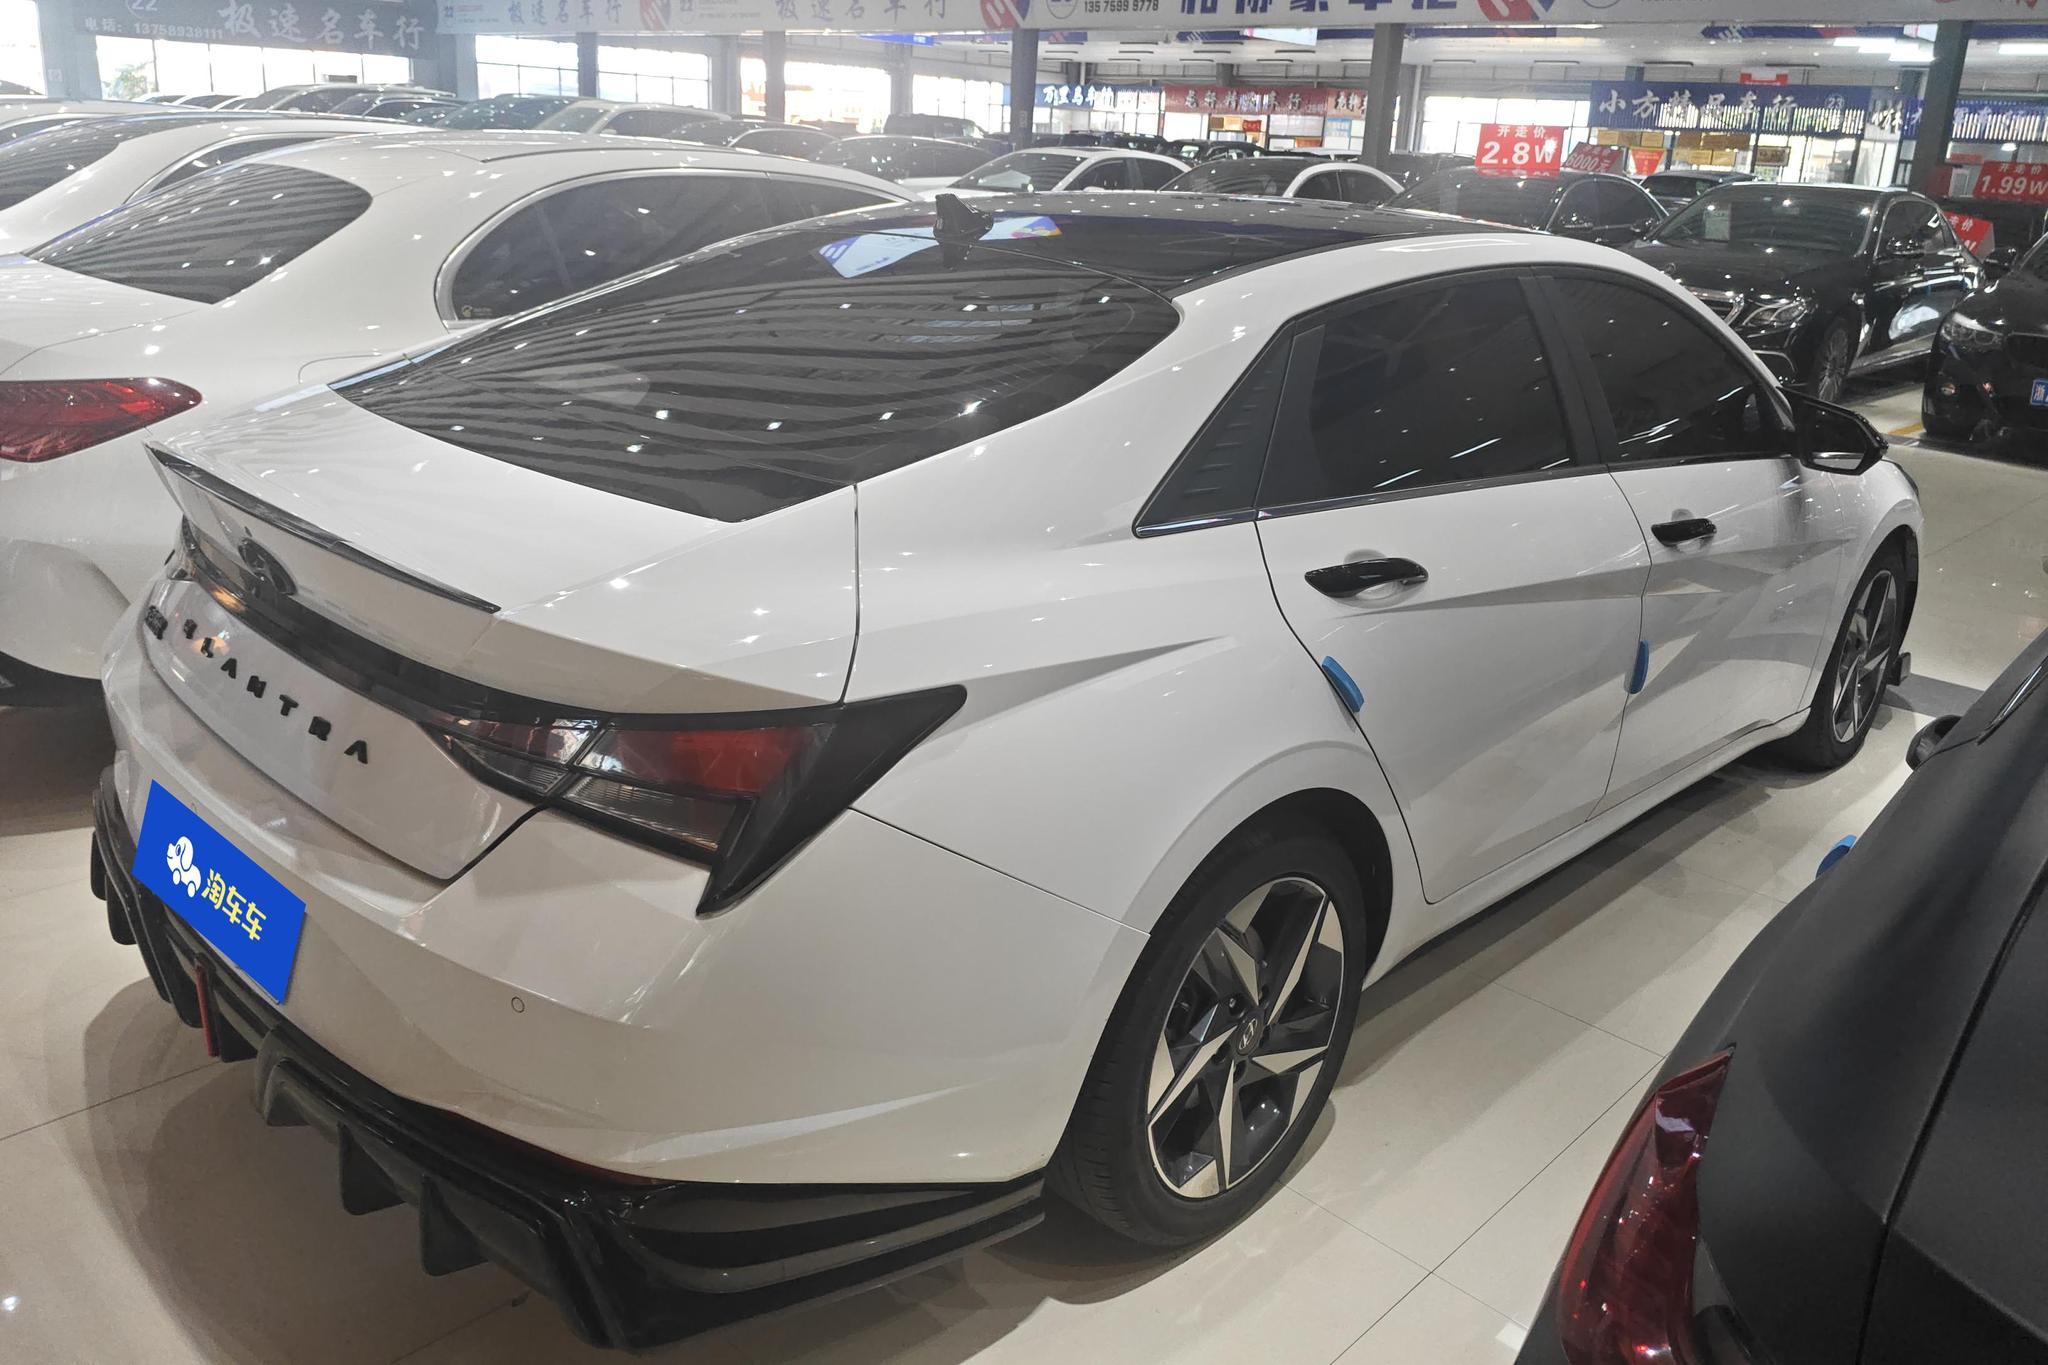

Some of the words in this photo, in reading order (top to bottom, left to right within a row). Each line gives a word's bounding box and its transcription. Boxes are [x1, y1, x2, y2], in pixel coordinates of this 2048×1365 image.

[1498, 125, 1547, 139] 开走价
[1481, 141, 1555, 165] 2.8W
[1981, 175, 2048, 195] 1.99W
[2034, 384, 2048, 402] 浙
[183, 618, 369, 765] ELANTRA
